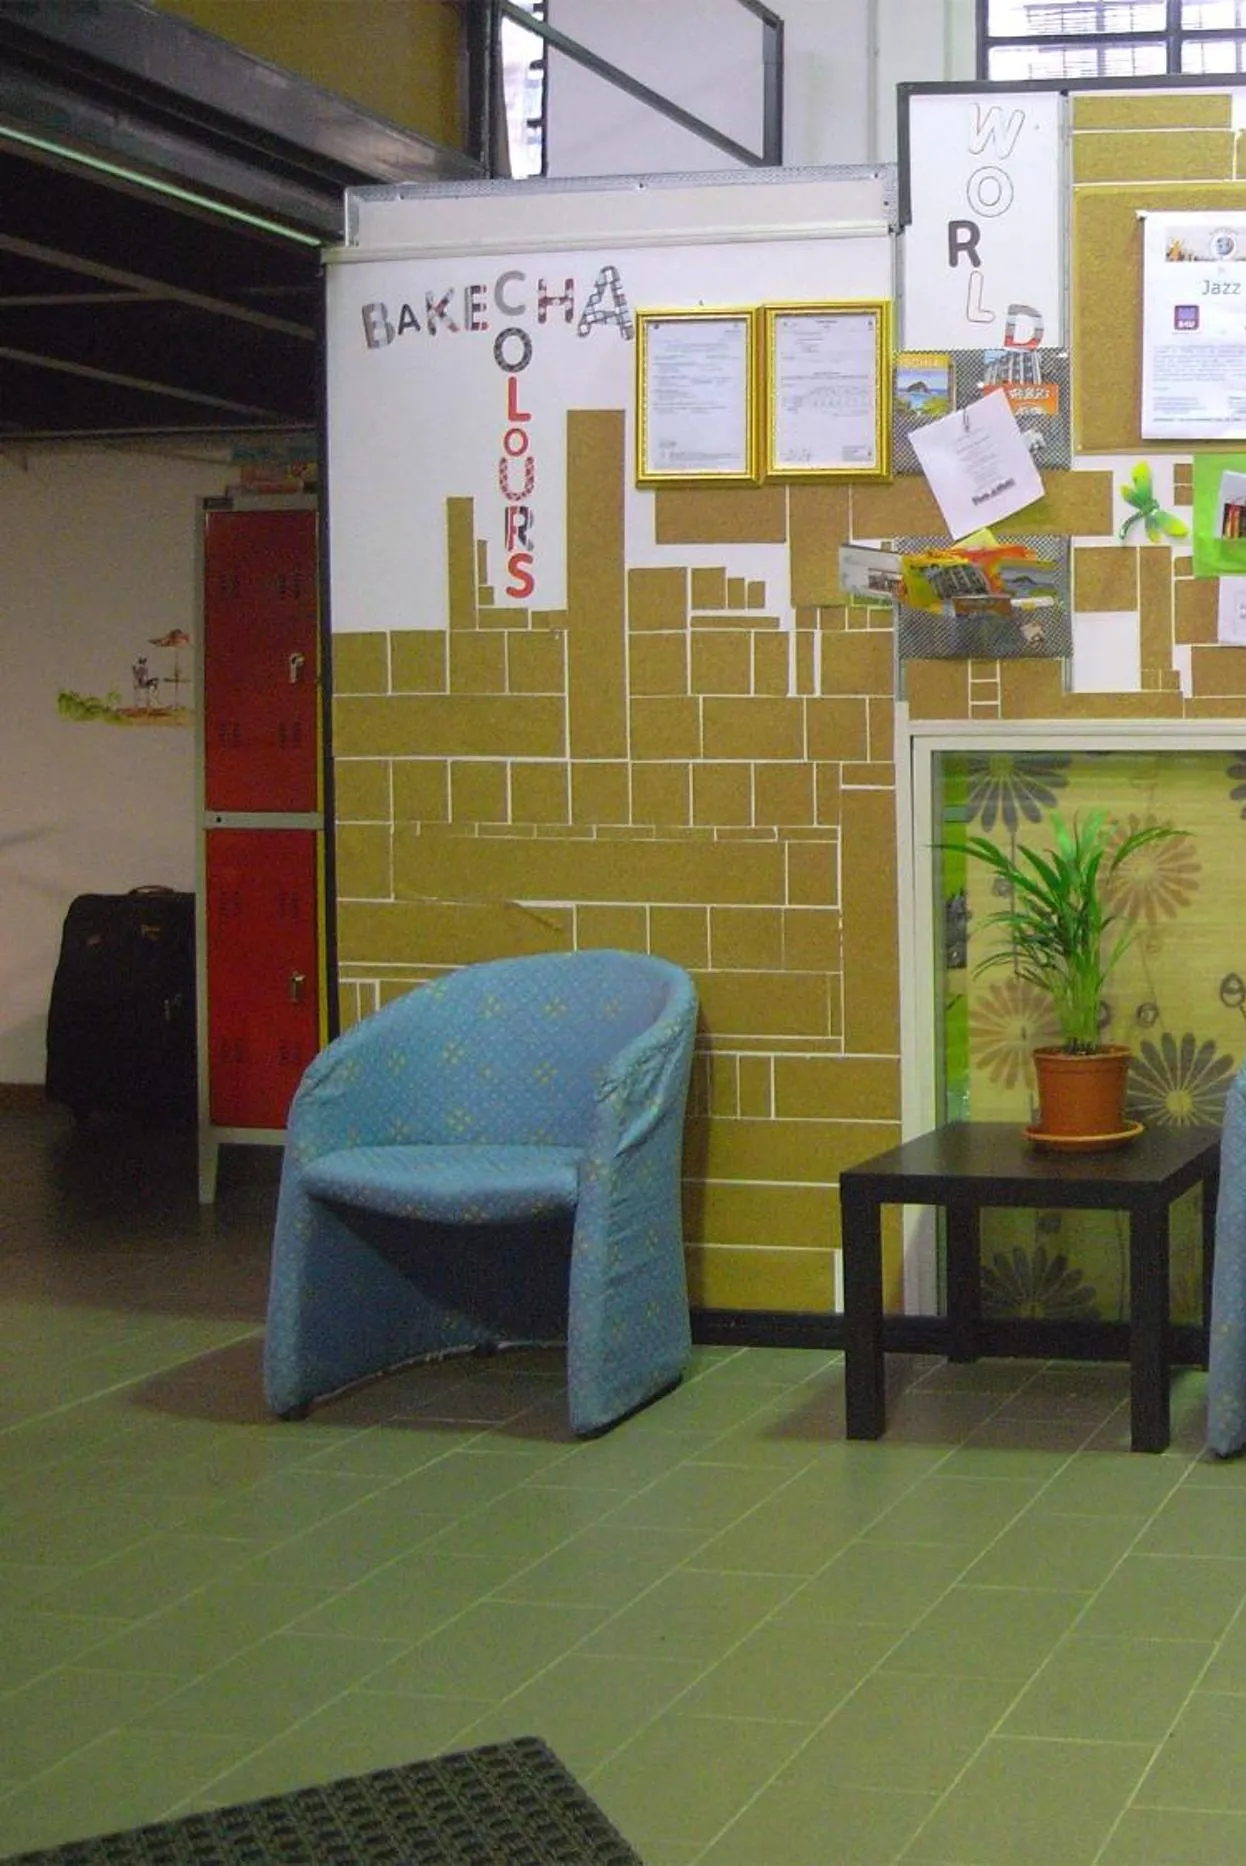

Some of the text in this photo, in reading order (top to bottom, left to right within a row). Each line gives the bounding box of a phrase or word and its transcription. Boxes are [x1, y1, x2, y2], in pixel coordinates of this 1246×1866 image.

[361, 265, 633, 350] BAKECHA
[948, 103, 1044, 350] WORLD
[1202, 279, 1242, 295] Jazz
[493, 271, 534, 599] COLOURS
